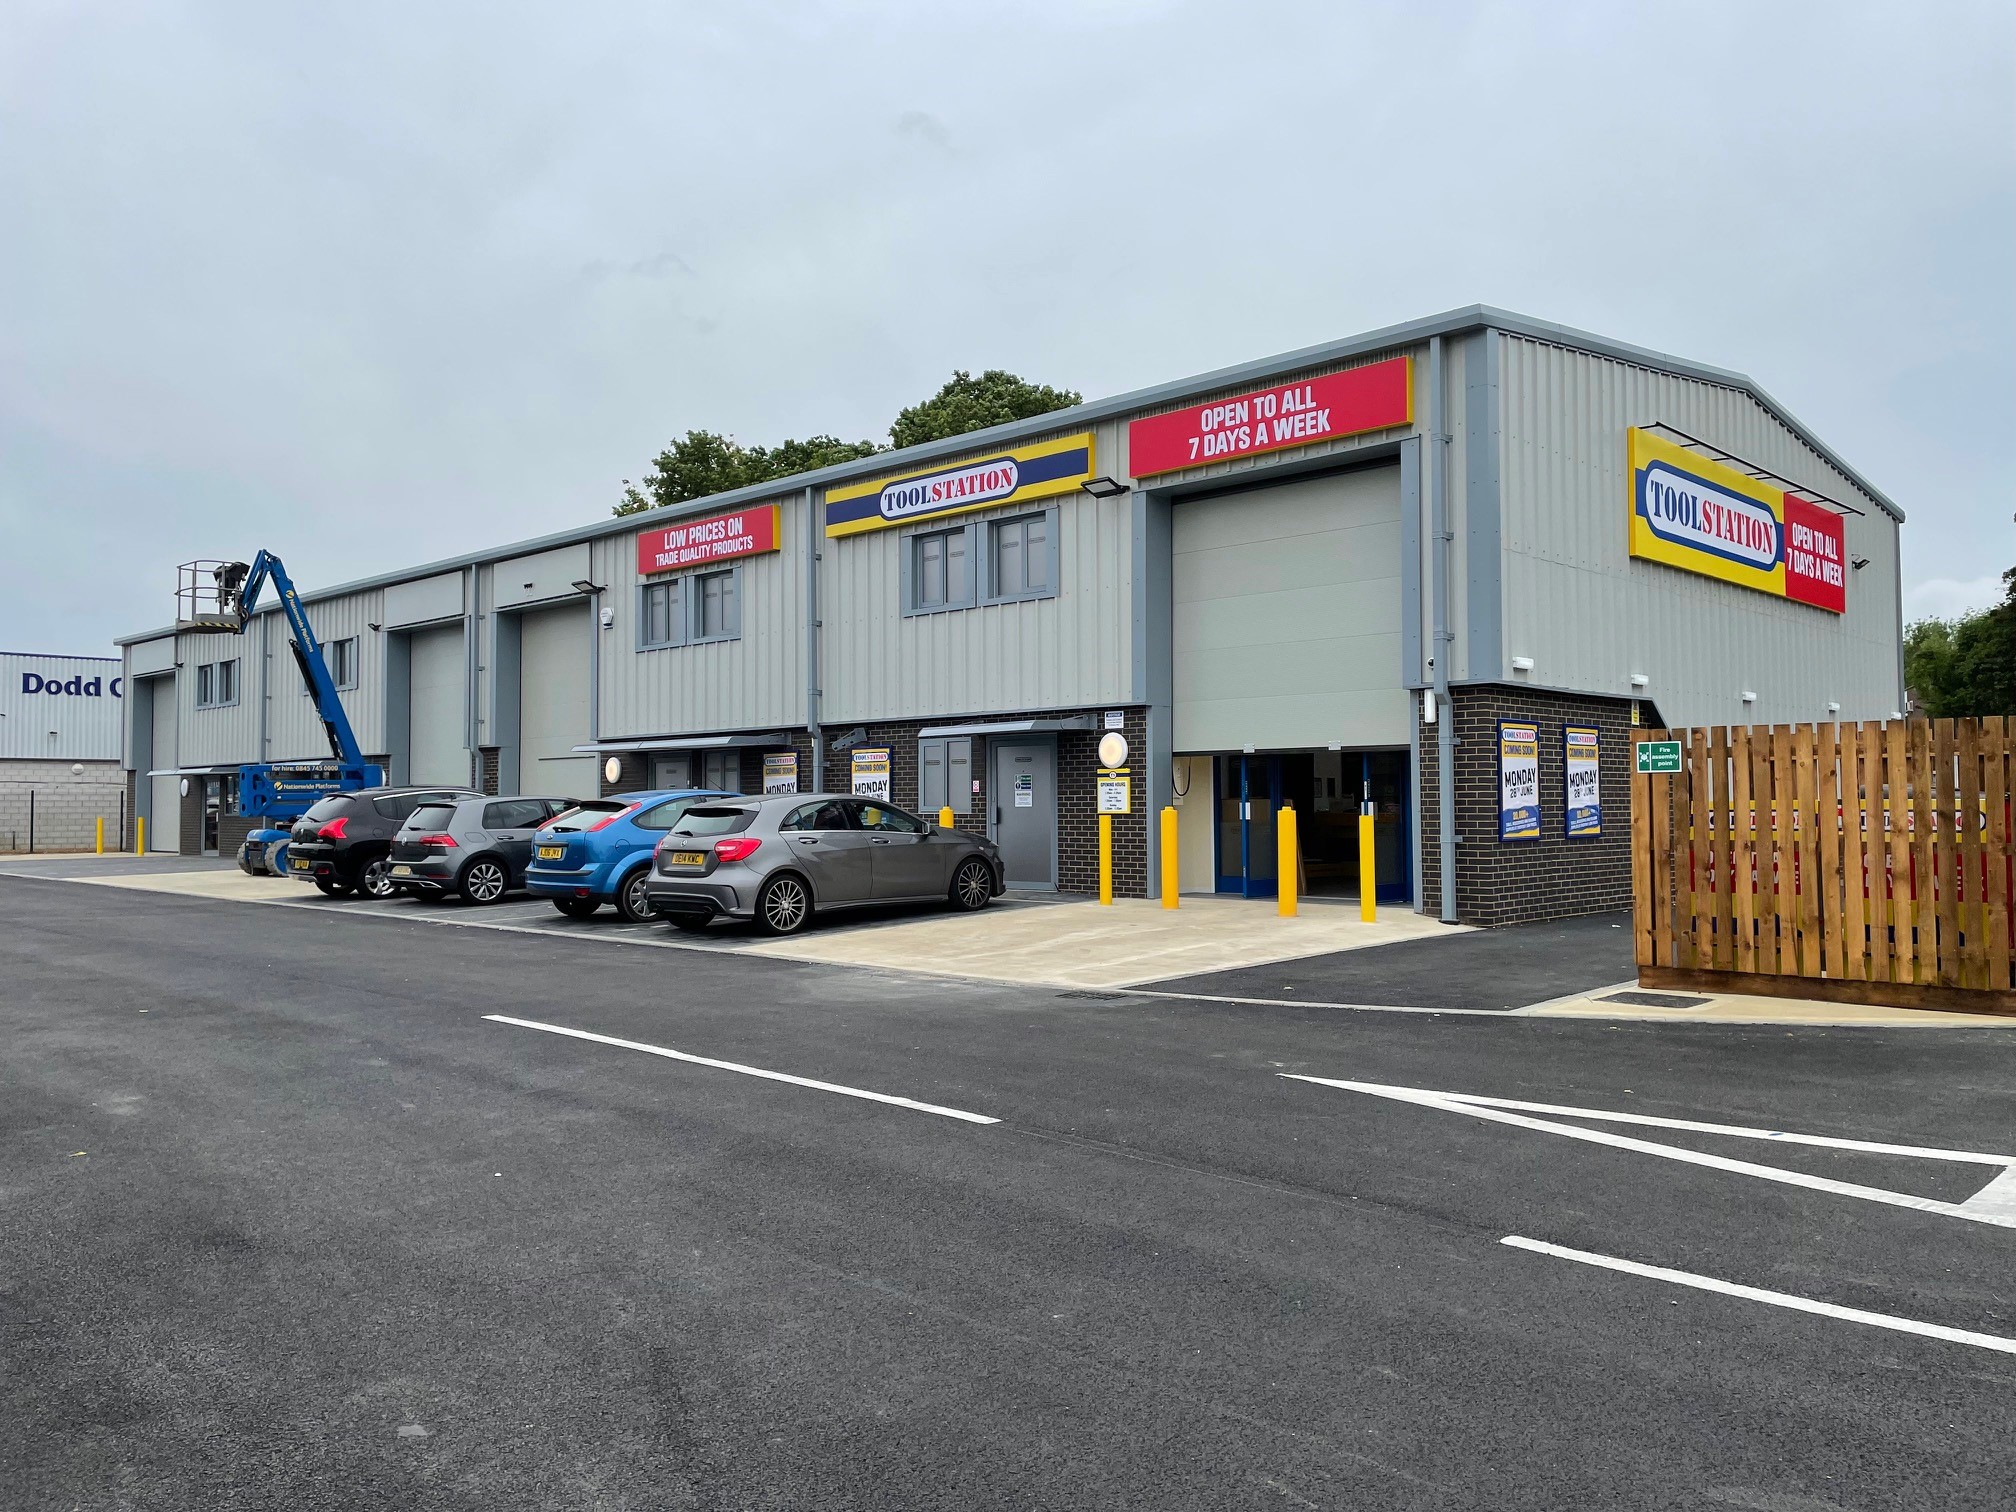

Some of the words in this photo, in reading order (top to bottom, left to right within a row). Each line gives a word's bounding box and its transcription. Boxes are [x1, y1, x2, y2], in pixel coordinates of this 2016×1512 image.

[1201, 401, 1249, 432] OPEN
[1254, 393, 1277, 420] TO
[1281, 385, 1317, 414] ALL
[1188, 437, 1200, 460] 7
[1203, 426, 1250, 457] DAYS
[1255, 422, 1269, 446] A
[1273, 408, 1331, 441] WEEK
[884, 466, 1013, 511] TOOLSTATION
[1650, 479, 1774, 555] TOOLSTATION
[664, 528, 687, 550] LOW
[689, 521, 725, 545] PRICES
[728, 516, 743, 537] ON
[1792, 522, 1813, 551] OPEN
[1814, 531, 1825, 556] TO
[1825, 534, 1838, 561] ALL
[655, 551, 678, 567] TRADE
[680, 543, 711, 563] QUALITY
[713, 535, 753, 556] PRODUCTS
[1787, 548, 1793, 571] 7
[1794, 549, 1815, 579] DAYS
[1815, 556, 1822, 581] A
[1822, 560, 1843, 588] WEEK
[22, 672, 102, 697] Dodd
[1504, 730, 1535, 740] TOOLSTATION
[1652, 753, 1679, 761] assembly
[766, 782, 796, 794] MONDAY
[854, 780, 888, 795] MONDAY
[1505, 767, 1536, 788] MONDAY
[1569, 769, 1598, 788] MONDAY
[1520, 785, 1533, 797] JUNE
[1583, 786, 1595, 797] JUNE
